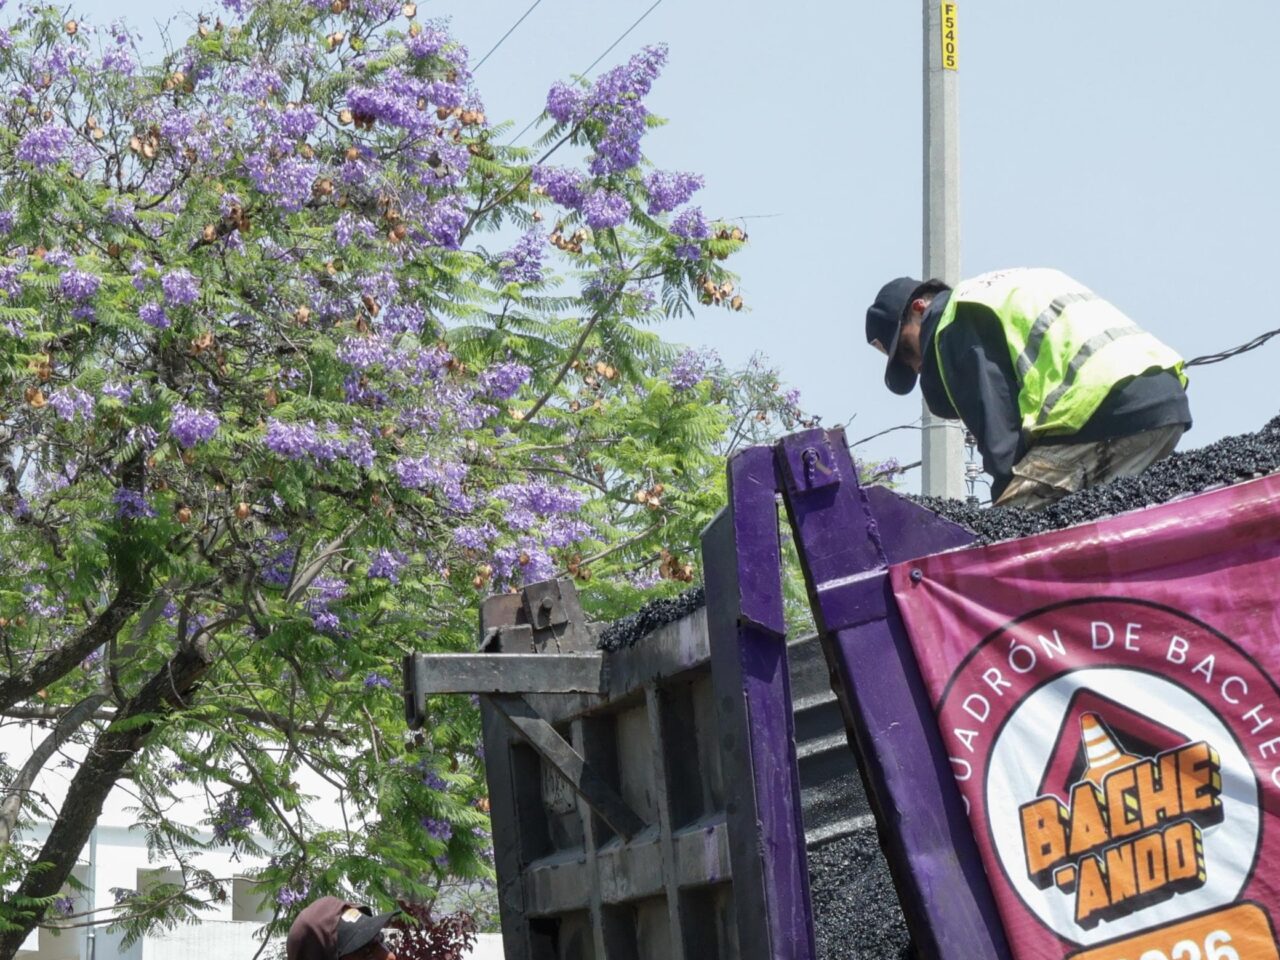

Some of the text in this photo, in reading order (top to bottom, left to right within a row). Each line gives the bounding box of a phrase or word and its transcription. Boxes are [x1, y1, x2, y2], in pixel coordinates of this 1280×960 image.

[945, 4, 955, 67] F5405
[949, 629, 1067, 816] UADRÓN
[1090, 621, 1141, 652] DE
[1019, 741, 1222, 886] BACHE
